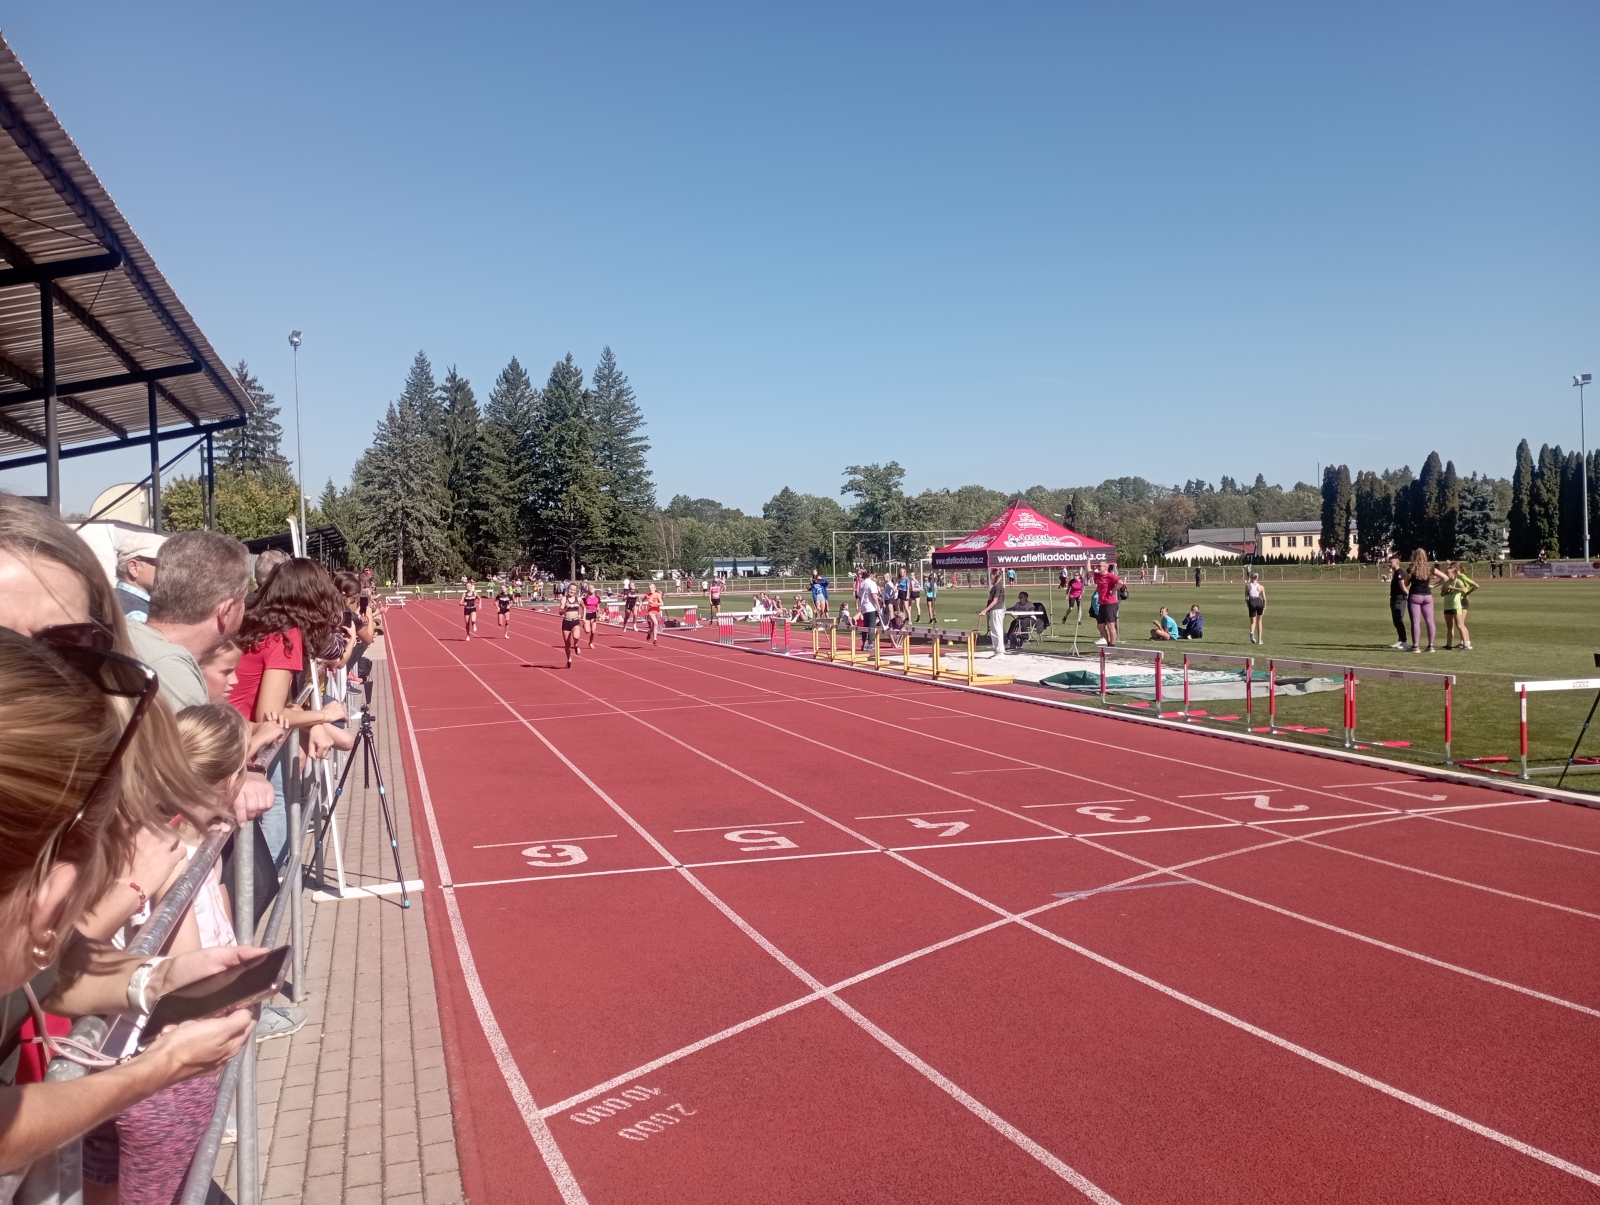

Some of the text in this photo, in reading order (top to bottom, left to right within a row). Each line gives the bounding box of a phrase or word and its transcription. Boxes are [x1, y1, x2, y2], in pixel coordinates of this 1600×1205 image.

[1222, 794, 1310, 812] 2
[1372, 786, 1448, 802] 1
[1076, 806, 1151, 823] 3
[906, 818, 971, 837] 4
[723, 829, 800, 852] 5
[521, 844, 589, 867] 6
[617, 1102, 698, 1141] 2000
